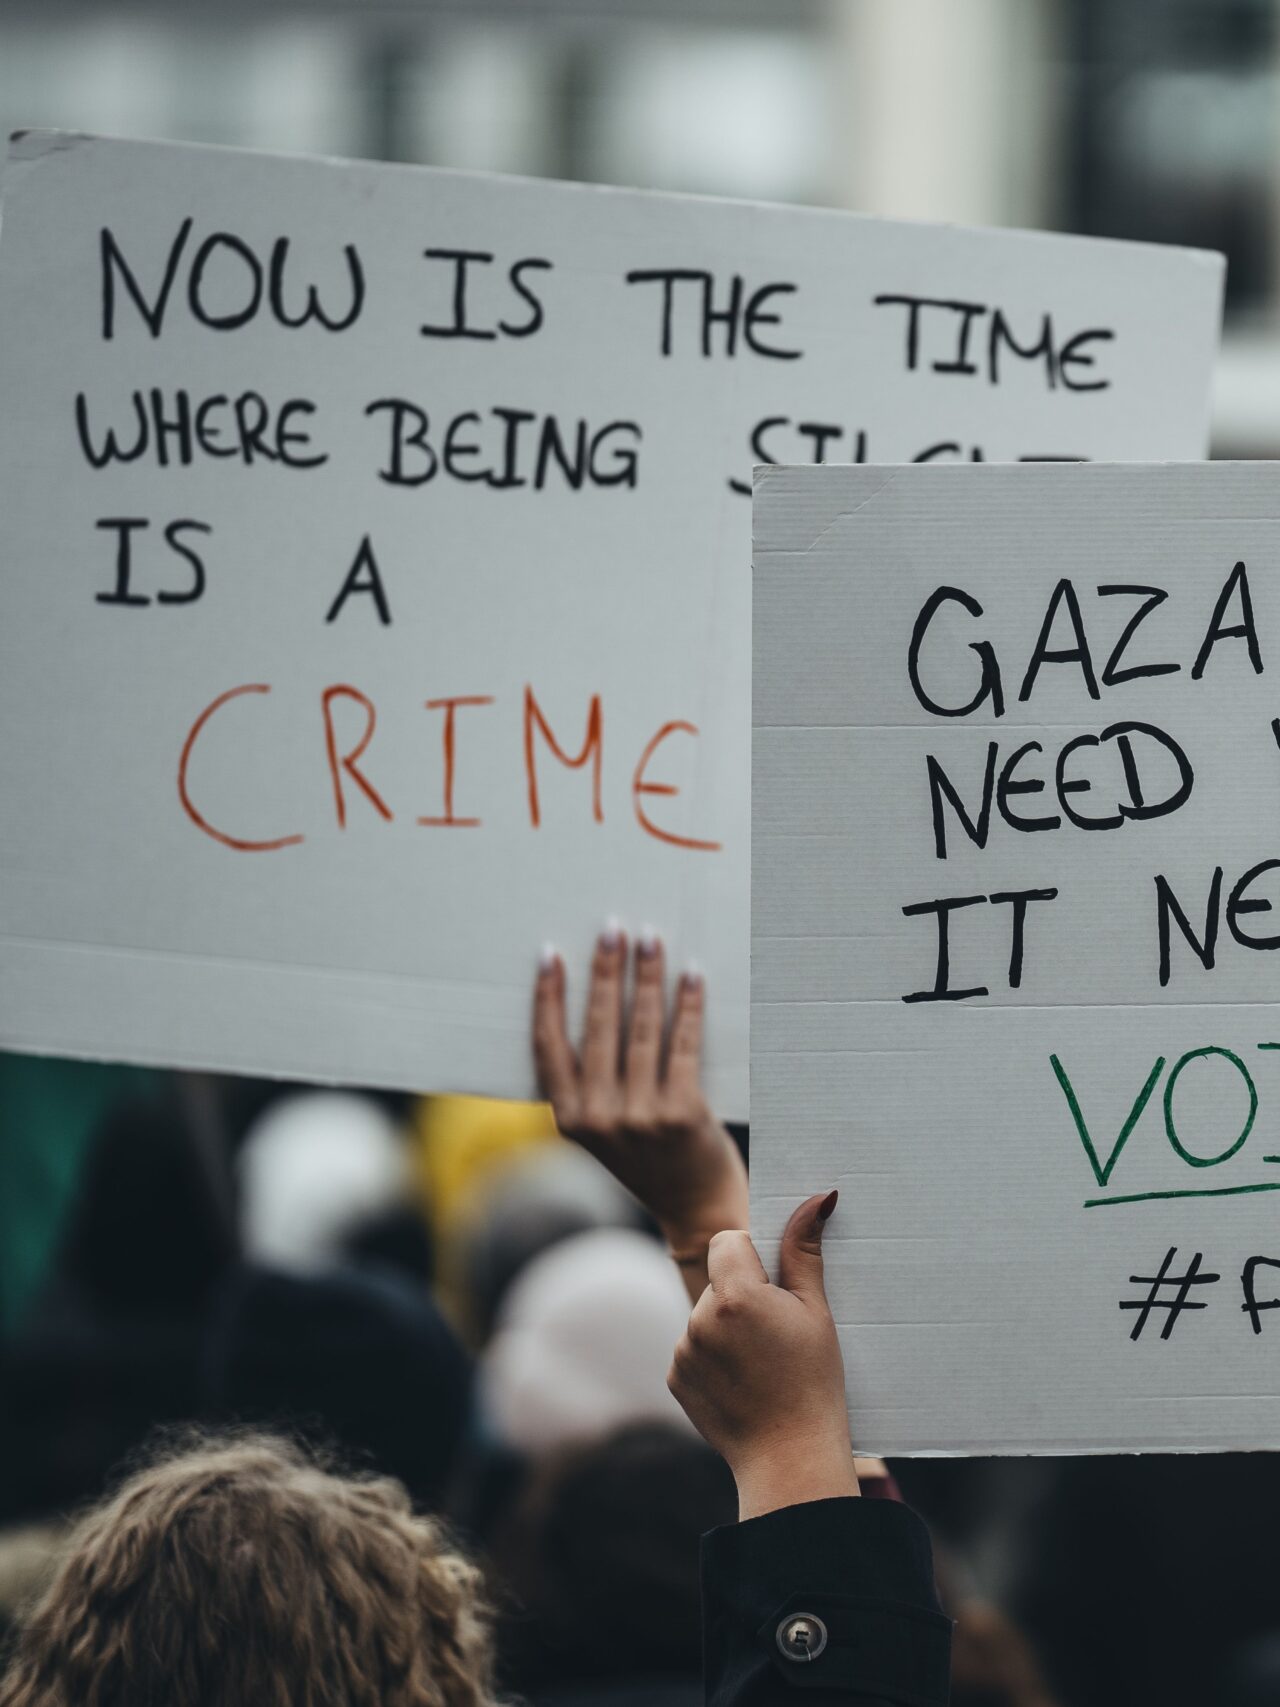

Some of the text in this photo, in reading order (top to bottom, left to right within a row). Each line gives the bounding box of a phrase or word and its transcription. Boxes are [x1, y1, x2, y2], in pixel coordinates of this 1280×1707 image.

[99, 216, 1117, 394] NOW IS THE TIME
[74, 387, 330, 471] WHERE
[363, 397, 643, 493] BEING
[94, 517, 393, 628] IS A
[908, 561, 1263, 717] GAZA
[177, 683, 722, 852] CRIME
[926, 721, 1194, 860] NEED
[901, 888, 1058, 1004] IT
